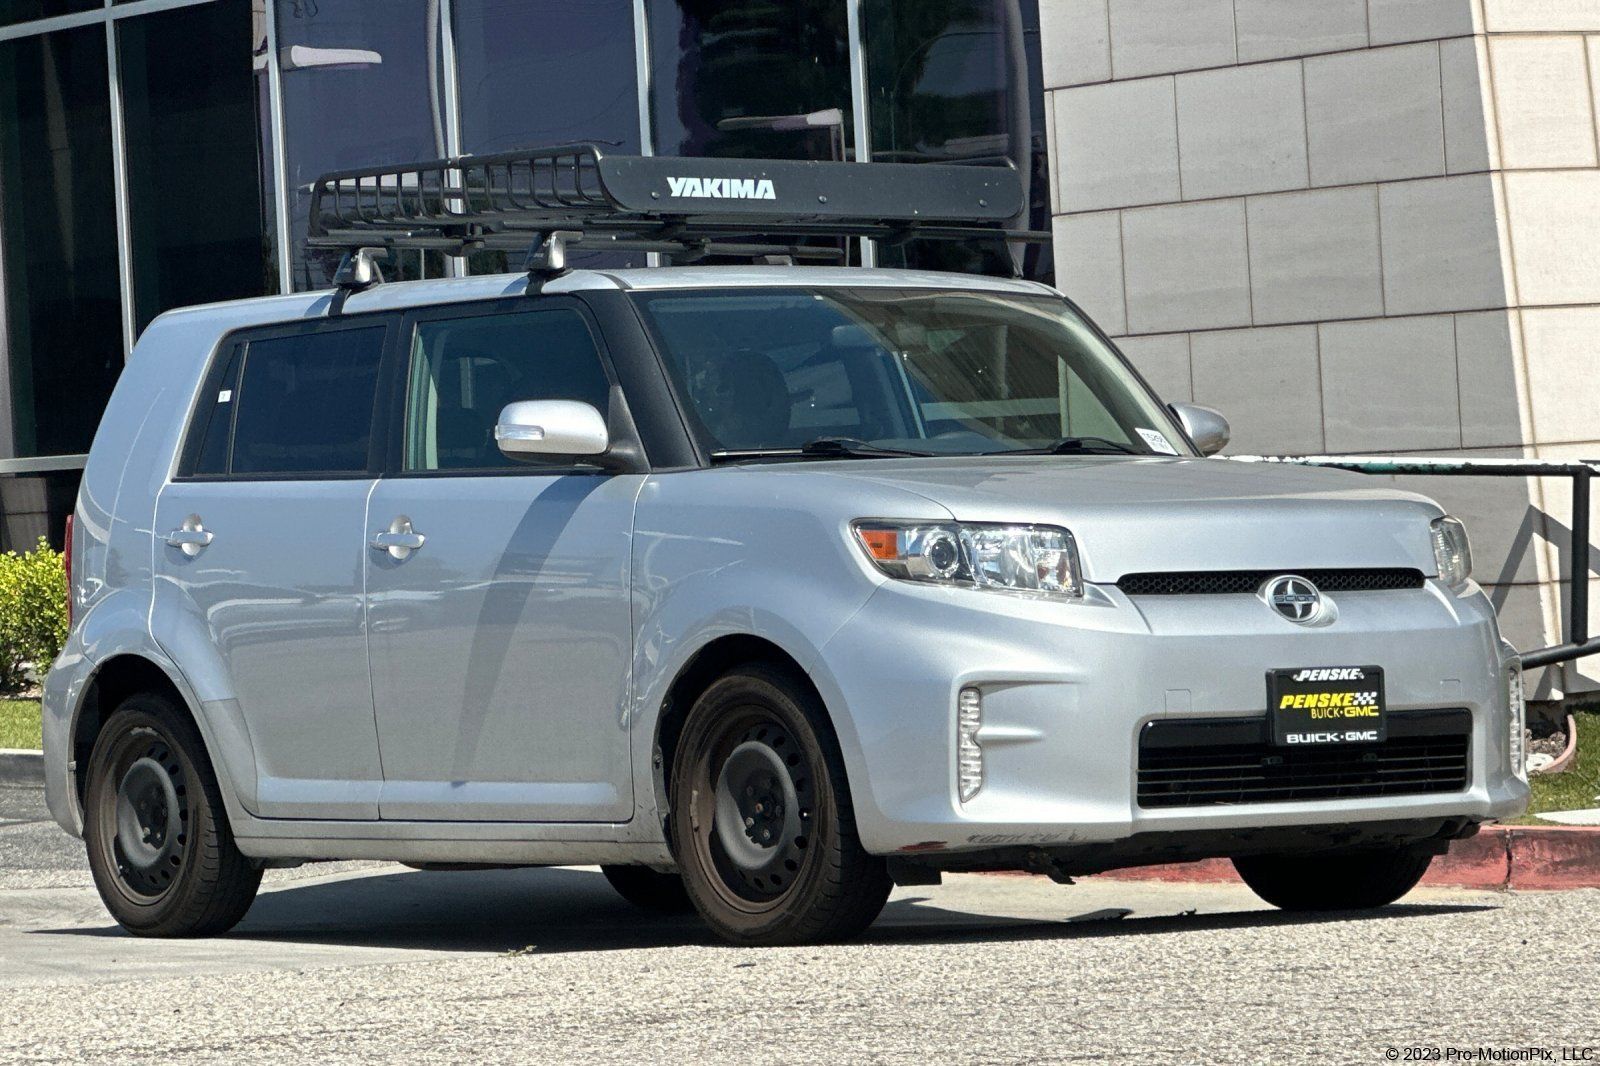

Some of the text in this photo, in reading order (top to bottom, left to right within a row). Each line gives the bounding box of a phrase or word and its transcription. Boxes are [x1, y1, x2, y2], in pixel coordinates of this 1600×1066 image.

[666, 177, 776, 199] YAKIMA
[1296, 668, 1361, 681] PENSKE
[1280, 692, 1355, 709] PENSKE
